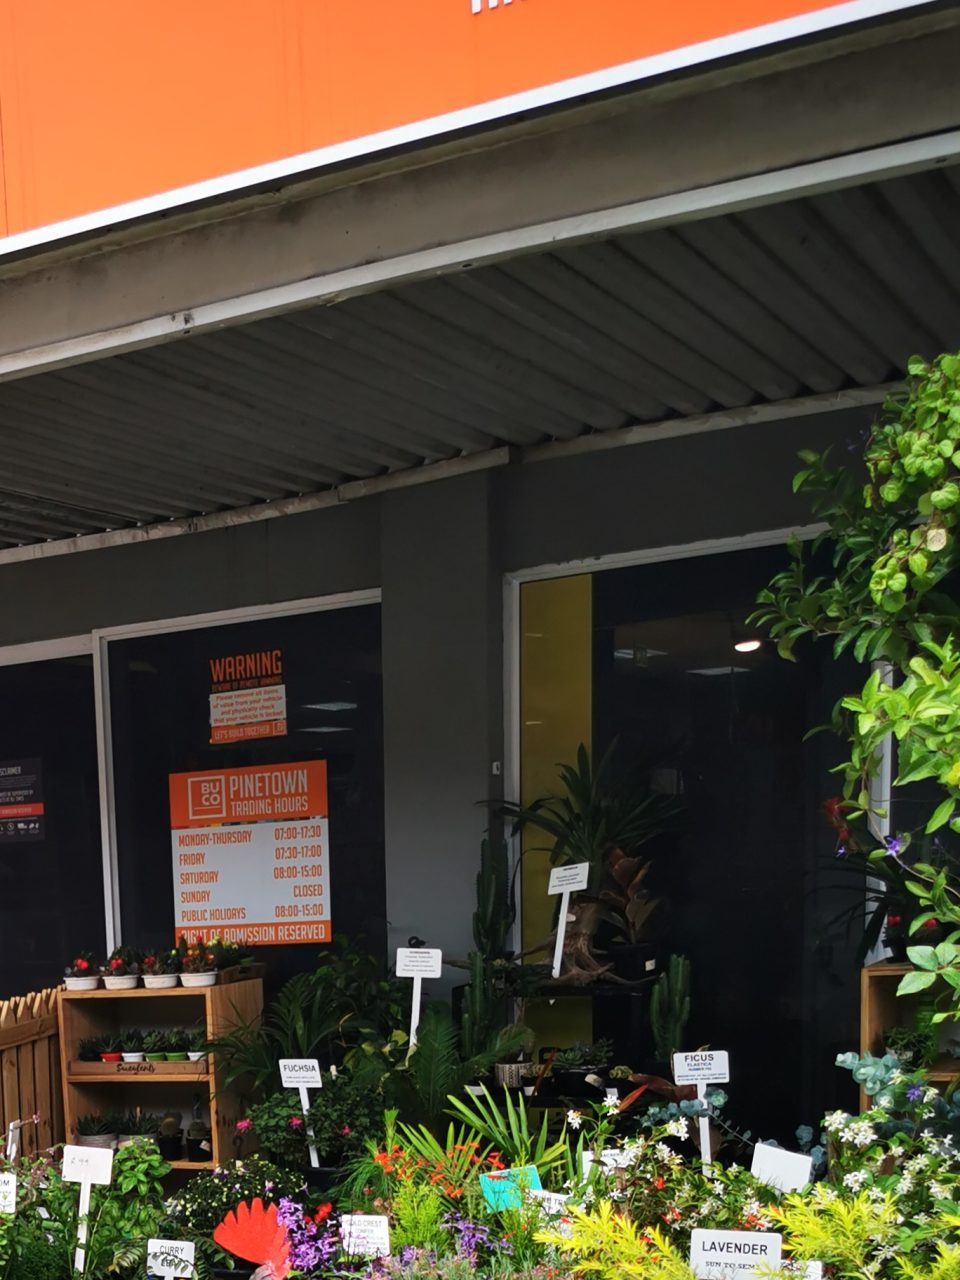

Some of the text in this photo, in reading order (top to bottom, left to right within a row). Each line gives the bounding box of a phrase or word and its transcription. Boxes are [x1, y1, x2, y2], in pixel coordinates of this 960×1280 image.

[209, 650, 282, 682] WARNING
[201, 782, 220, 793] BU
[229, 769, 308, 799] PINETOWN
[201, 794, 221, 806] CO
[231, 795, 308, 817] TRADING HOURS
[178, 830, 252, 847] MONDAY-THURSDAY
[179, 852, 205, 866] FRIDAY
[275, 845, 322, 860] 07:30-17:00
[180, 870, 219, 885] SATURDAY
[274, 864, 322, 879] 08:00-15:00
[181, 890, 211, 903] SUNDAY
[293, 884, 323, 897] CLOSED
[181, 907, 246, 922] PUBLIC HOLIDAYS
[275, 904, 323, 918] 08:00-15:00
[224, 926, 275, 943] ADMISSION
[278, 924, 325, 941] RESERVED
[684, 1053, 714, 1062] FICUS
[283, 1064, 317, 1073] FUCHSIA
[159, 1245, 185, 1255] CURRY
[702, 1241, 768, 1256] LAVENDER
